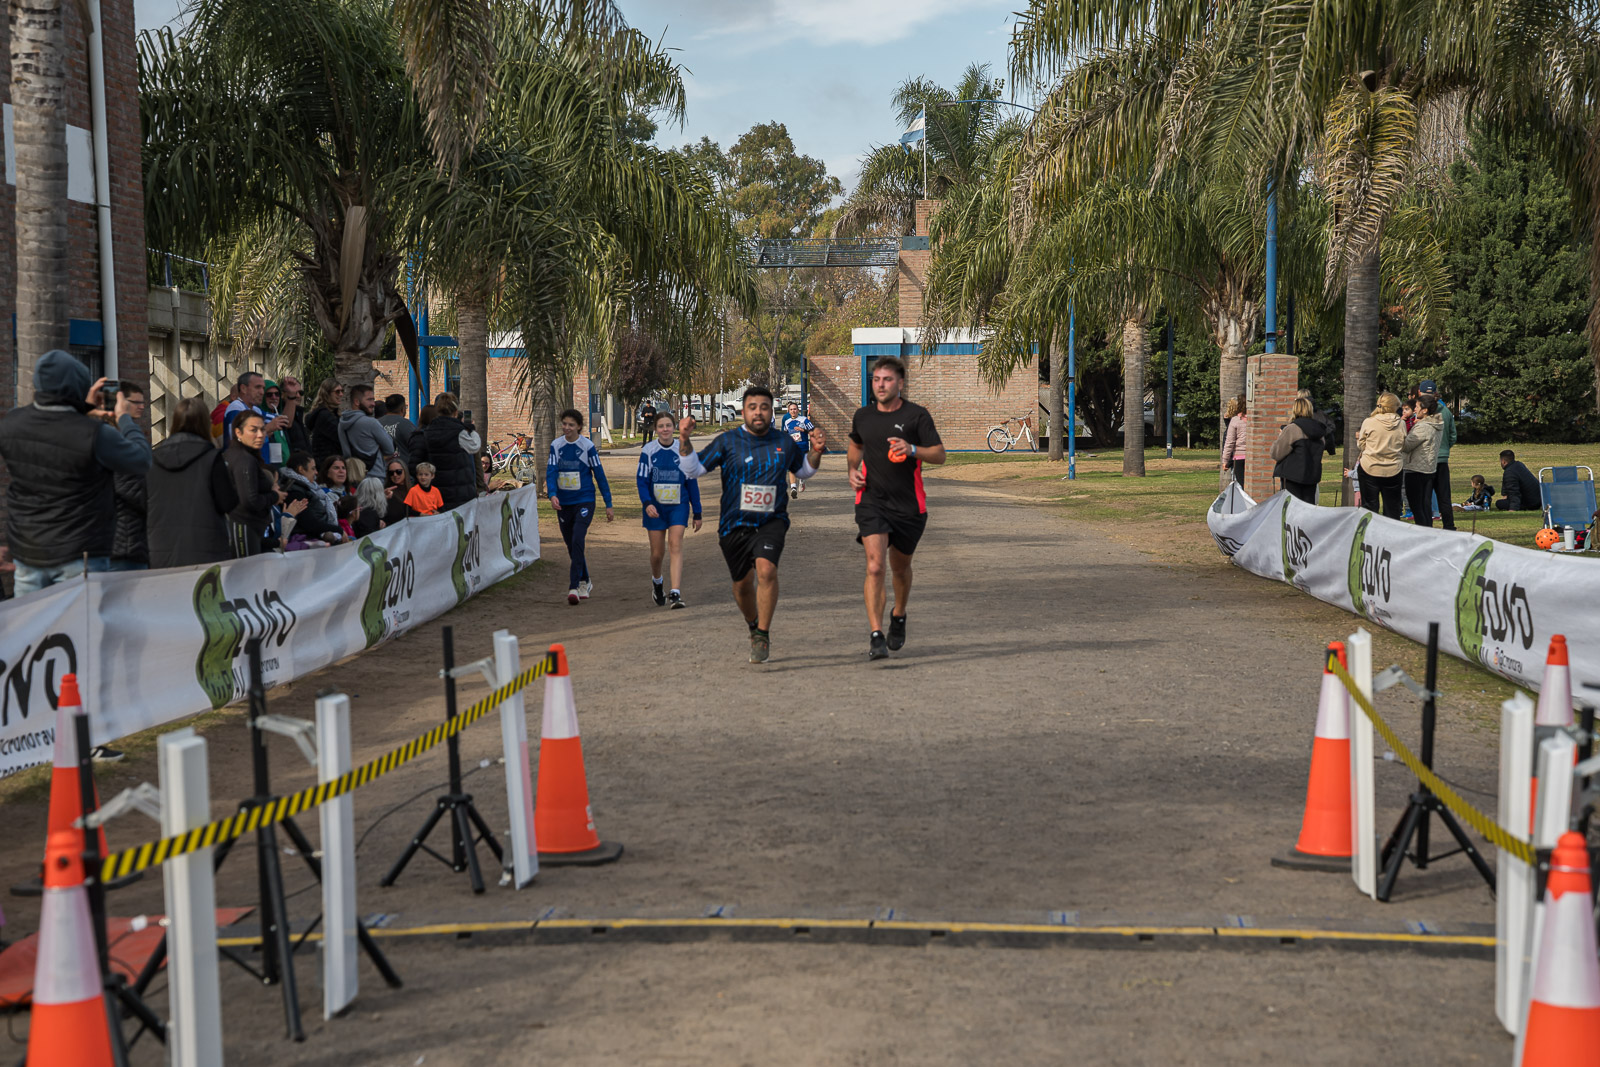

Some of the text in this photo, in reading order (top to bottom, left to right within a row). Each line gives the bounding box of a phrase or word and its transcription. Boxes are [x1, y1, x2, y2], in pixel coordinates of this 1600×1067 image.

[657, 489, 678, 499] 723
[744, 491, 773, 505] 520
[0, 727, 56, 756] cronorav
